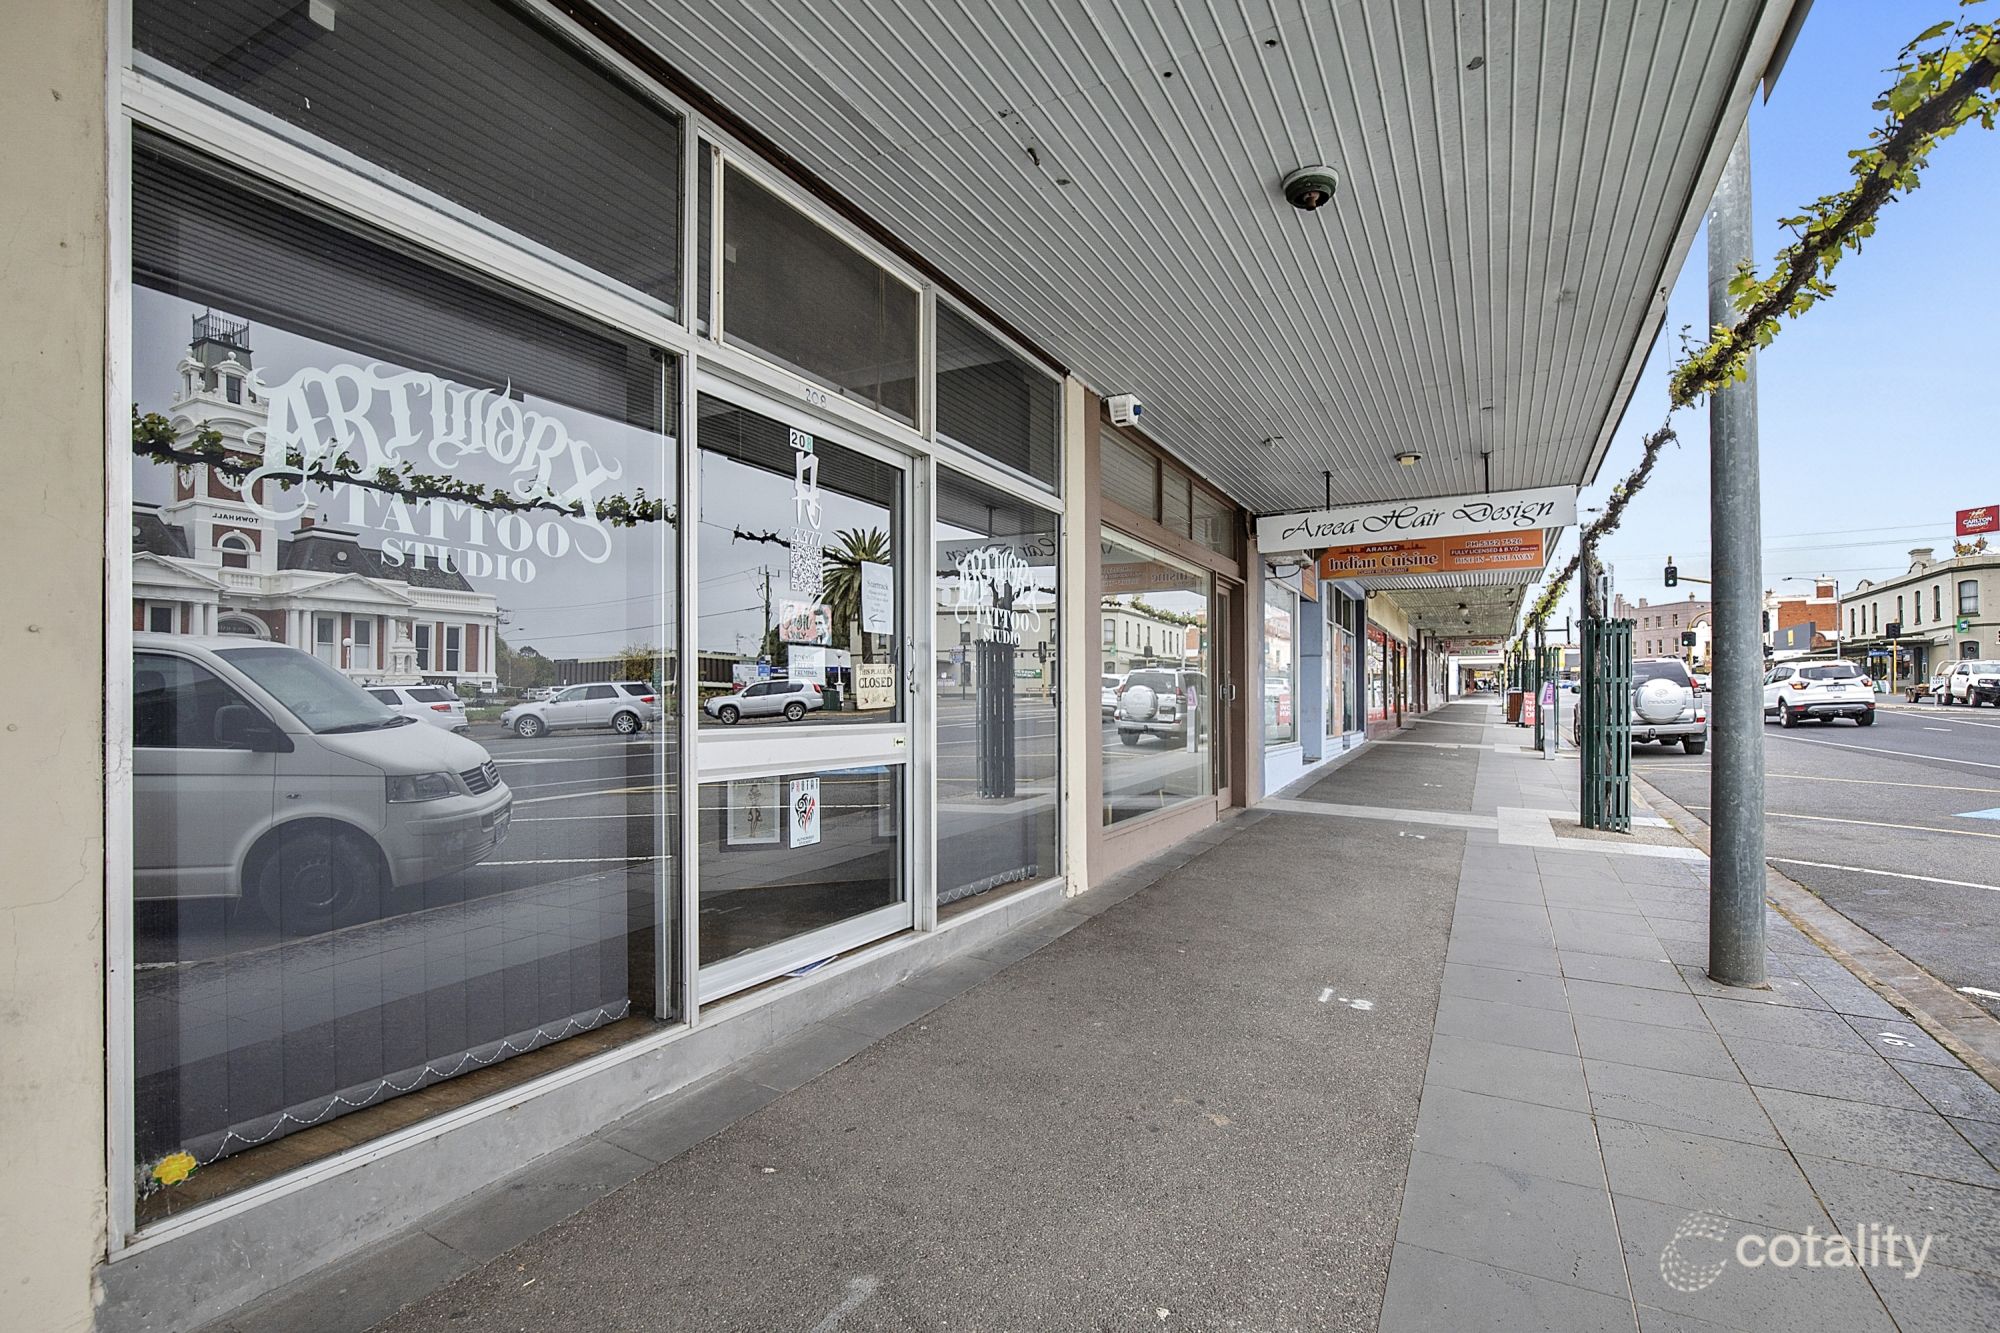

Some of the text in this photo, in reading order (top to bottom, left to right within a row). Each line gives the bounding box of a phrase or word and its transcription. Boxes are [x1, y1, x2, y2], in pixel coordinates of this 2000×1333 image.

[805, 388, 827, 408] 208
[791, 432, 812, 451] 208
[333, 481, 571, 558] TATTOO
[1362, 505, 1446, 532] Hair
[1453, 500, 1555, 527] Design
[1963, 516, 1993, 526] CARLTON
[791, 527, 823, 547] 3377
[380, 536, 537, 584] STUDIO
[1328, 552, 1439, 571] Indian Cuisine
[1511, 552, 1534, 560] AWAY
[977, 605, 1029, 632] TATTOO
[984, 628, 1021, 645] STUDIO
[859, 677, 893, 688] CLOSED
